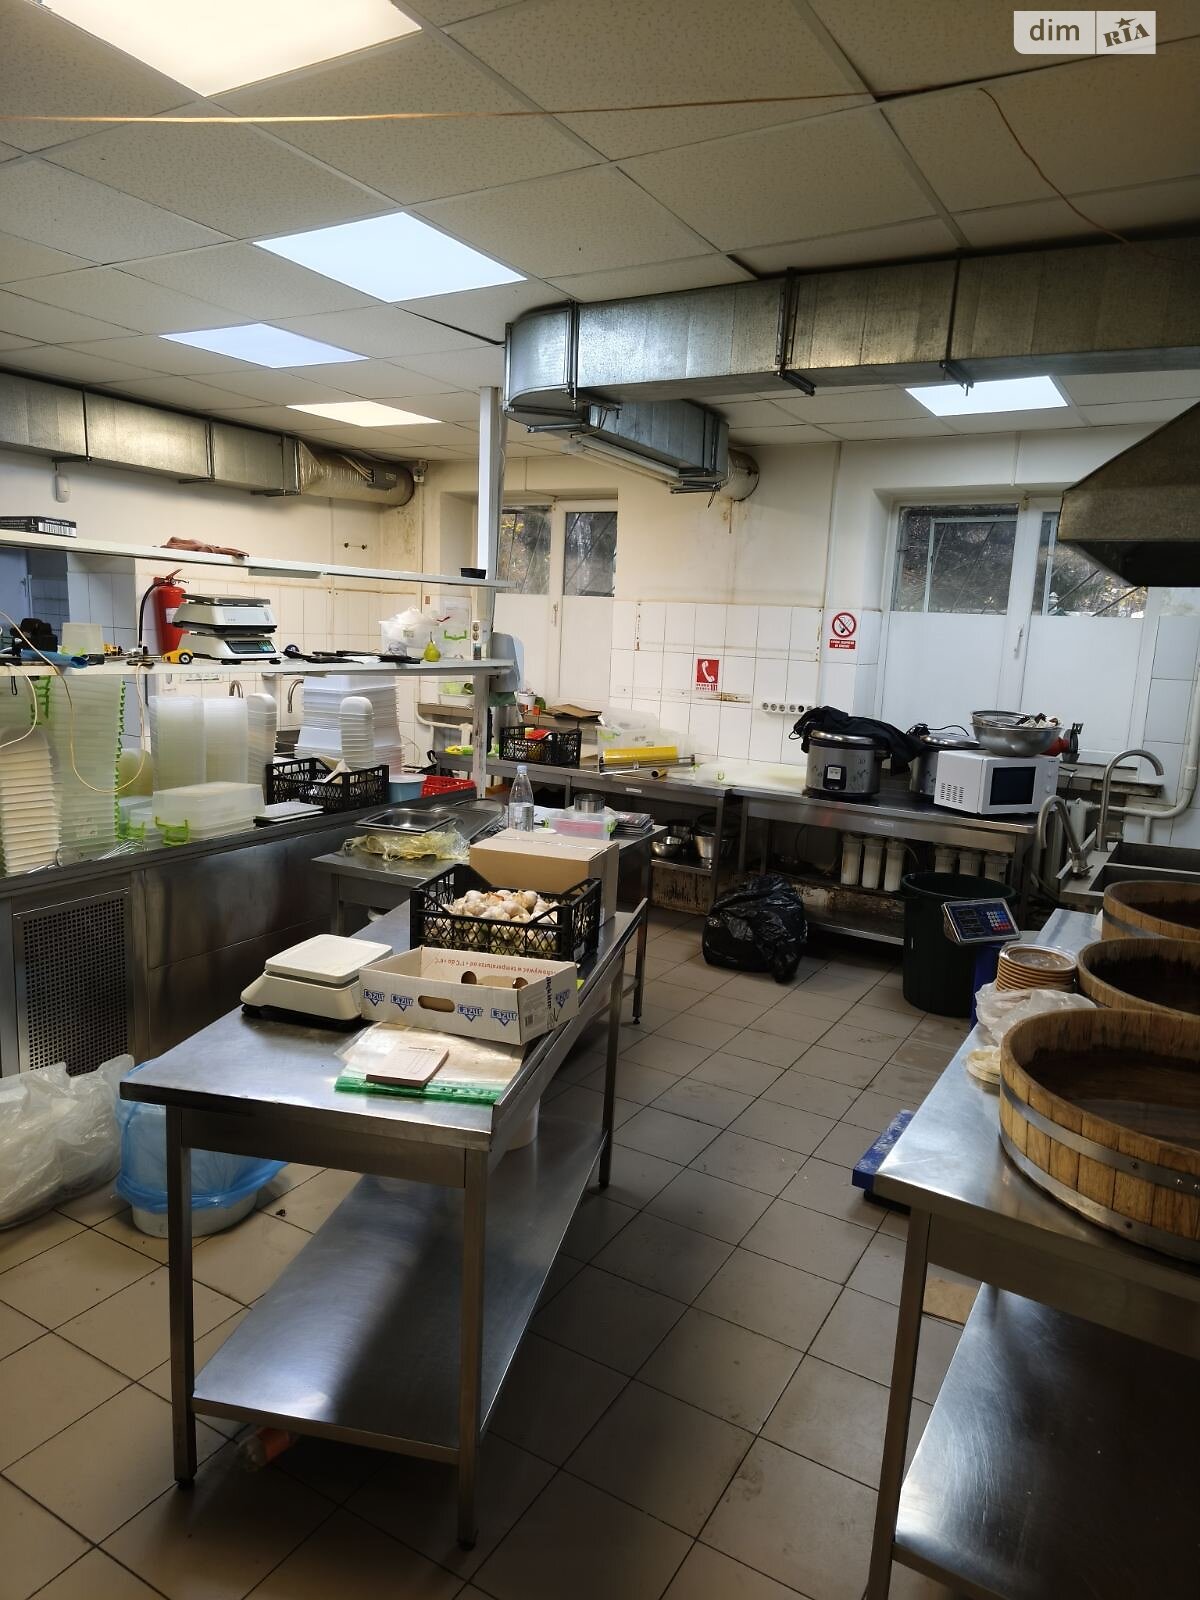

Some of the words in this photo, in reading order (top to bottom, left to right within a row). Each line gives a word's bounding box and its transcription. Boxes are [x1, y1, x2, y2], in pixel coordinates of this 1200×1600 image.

[364, 988, 384, 1002] Lazur
[391, 994, 414, 1006] Lazur
[458, 1004, 483, 1016] Lazur
[491, 1008, 518, 1021] Lazur
